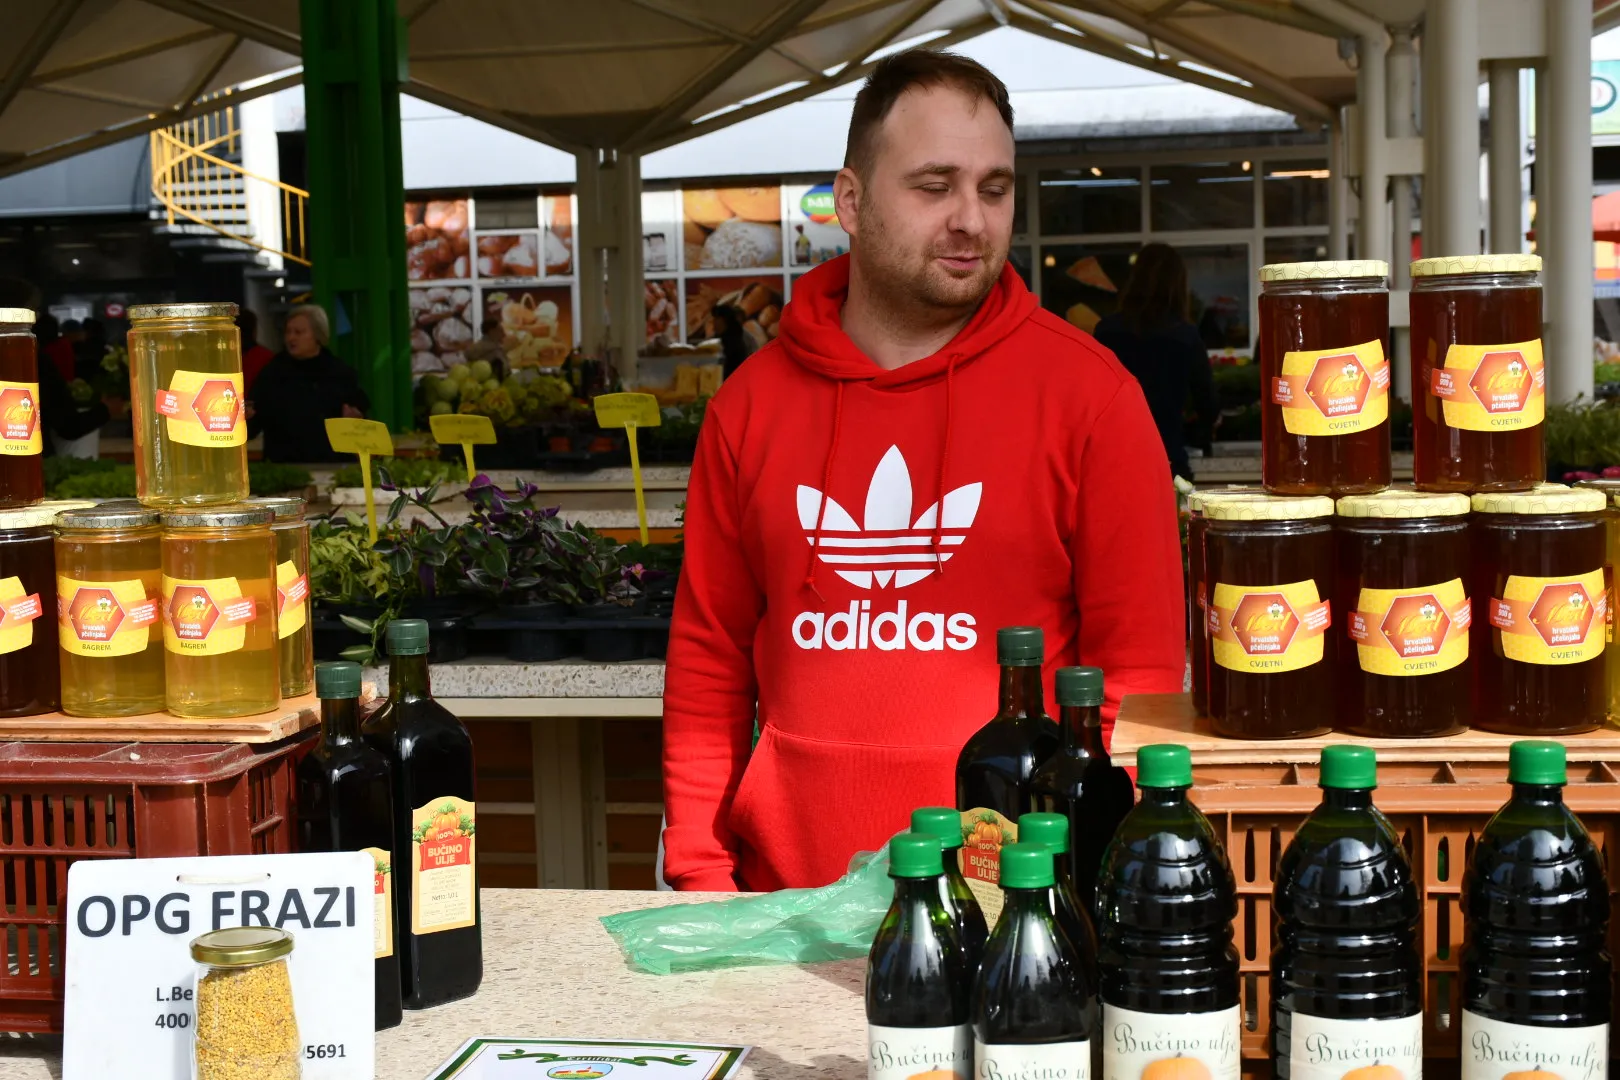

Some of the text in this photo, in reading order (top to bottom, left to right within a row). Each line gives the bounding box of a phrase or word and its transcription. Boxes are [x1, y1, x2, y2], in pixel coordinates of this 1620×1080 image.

[792, 600, 977, 651] adidas
[437, 831, 454, 840] 100%
[428, 844, 463, 857] BUČINO
[978, 842, 996, 850] 100%
[436, 854, 455, 865] ULJE
[970, 855, 1000, 870] BUČIN
[977, 868, 997, 880] ULJE
[77, 886, 355, 937] OPG FRAZI
[155, 1012, 191, 1028] 400
[1114, 1022, 1200, 1054] Bučino
[302, 1044, 346, 1059] 5691
[1306, 1032, 1396, 1064] Bučino
[1472, 1031, 1560, 1063] Bučino
[871, 1041, 956, 1071] Bučino
